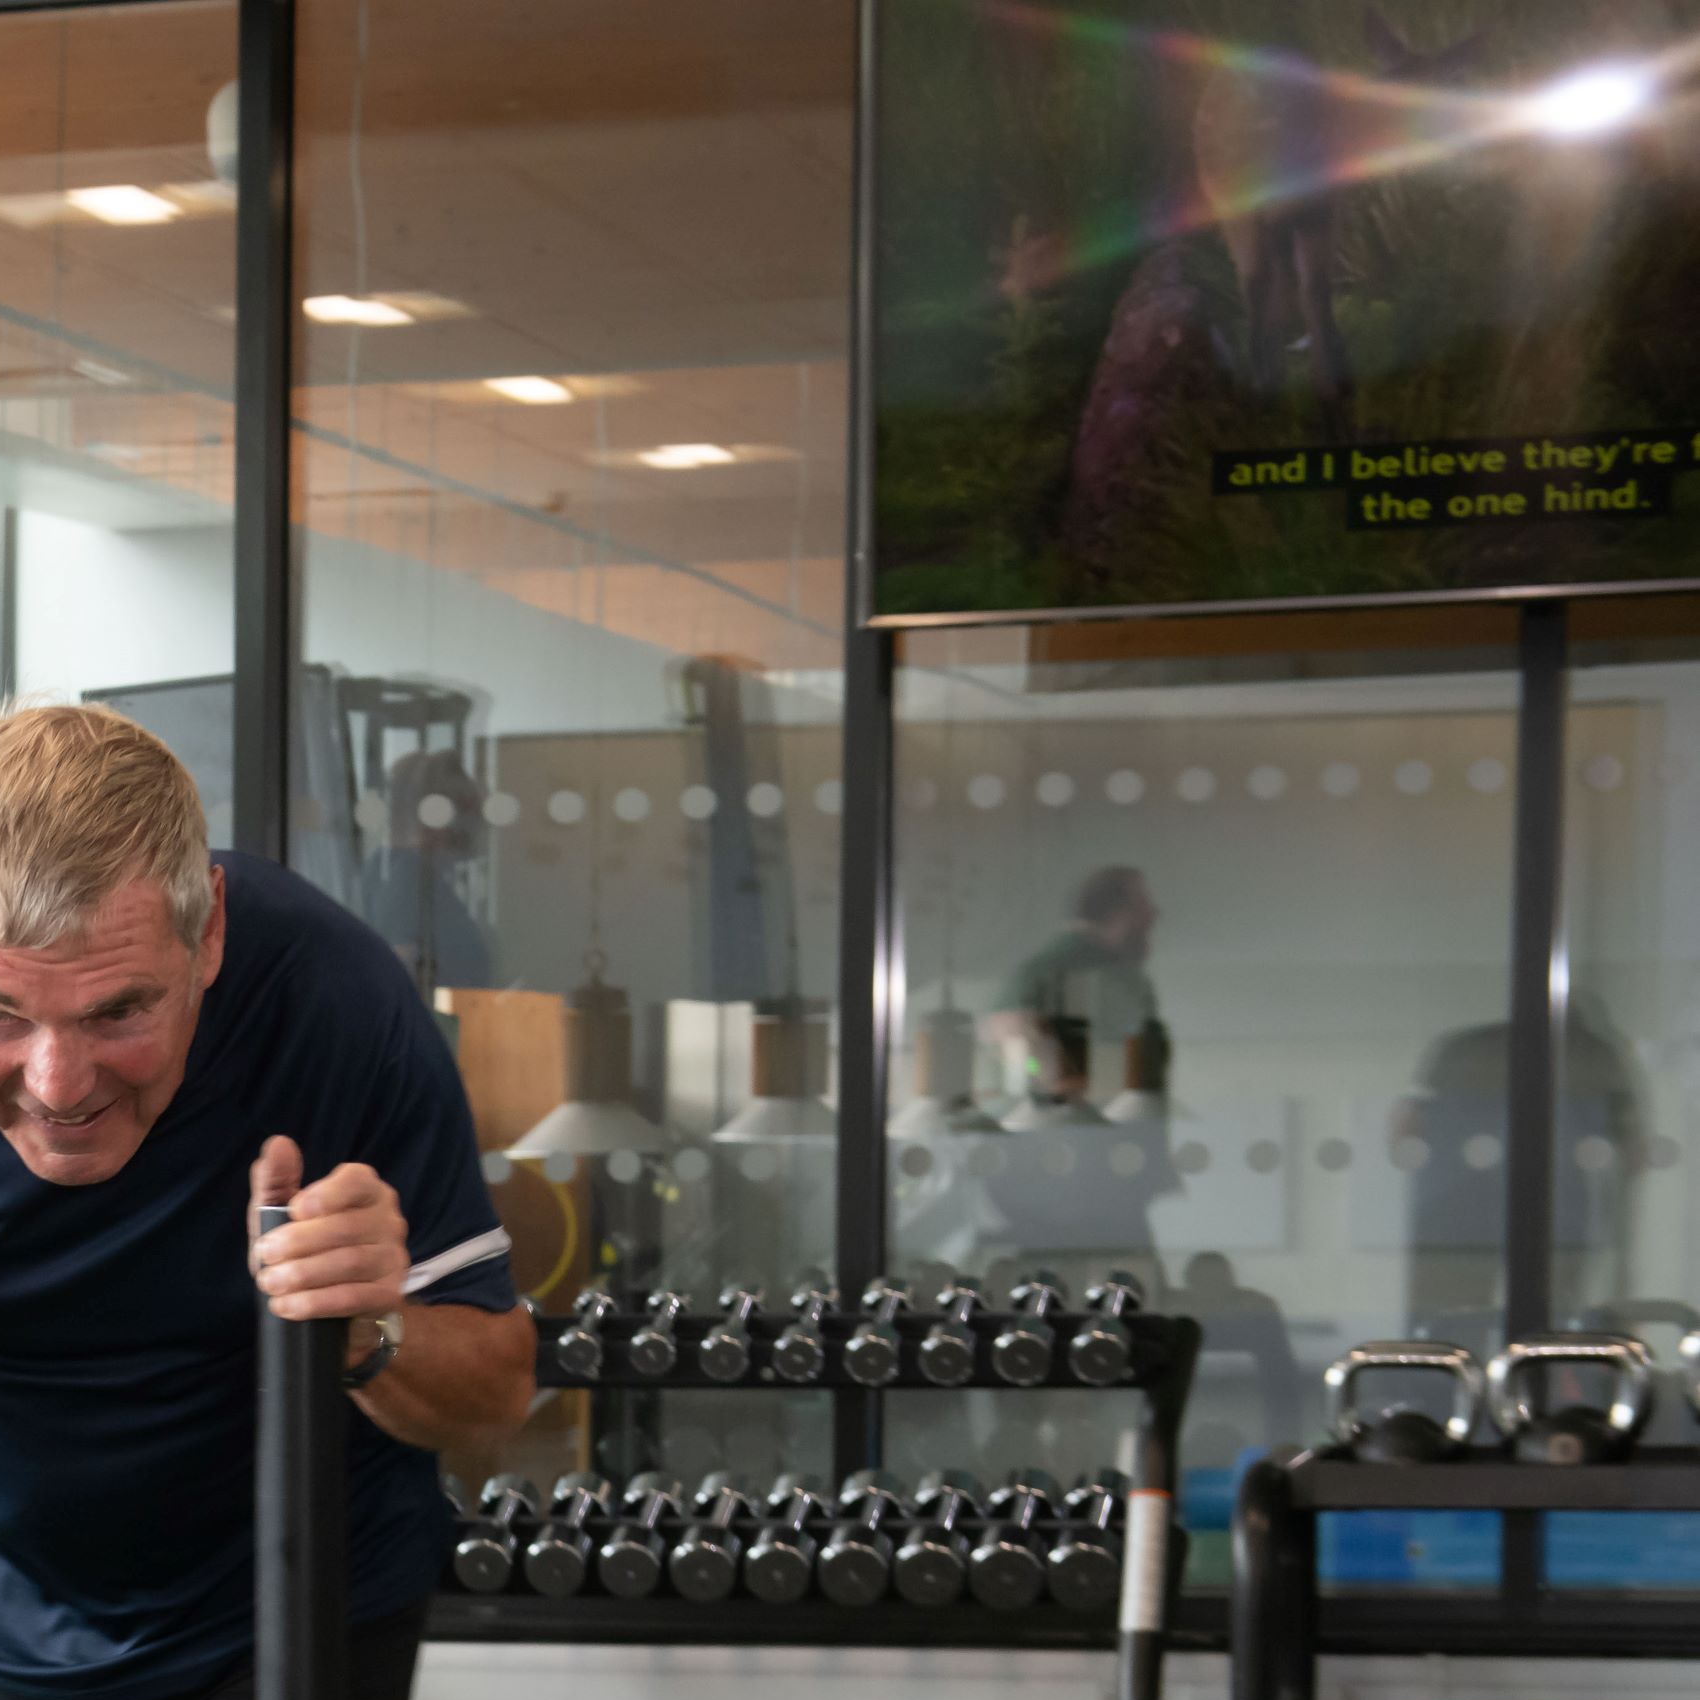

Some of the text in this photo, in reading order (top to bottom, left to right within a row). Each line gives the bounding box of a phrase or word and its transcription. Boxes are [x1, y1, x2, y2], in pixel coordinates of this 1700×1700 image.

[1228, 454, 1307, 487] and
[1322, 453, 1335, 480] I
[1350, 446, 1506, 481] believe
[1522, 438, 1676, 474] they're
[1361, 479, 1653, 524] the one hind.
